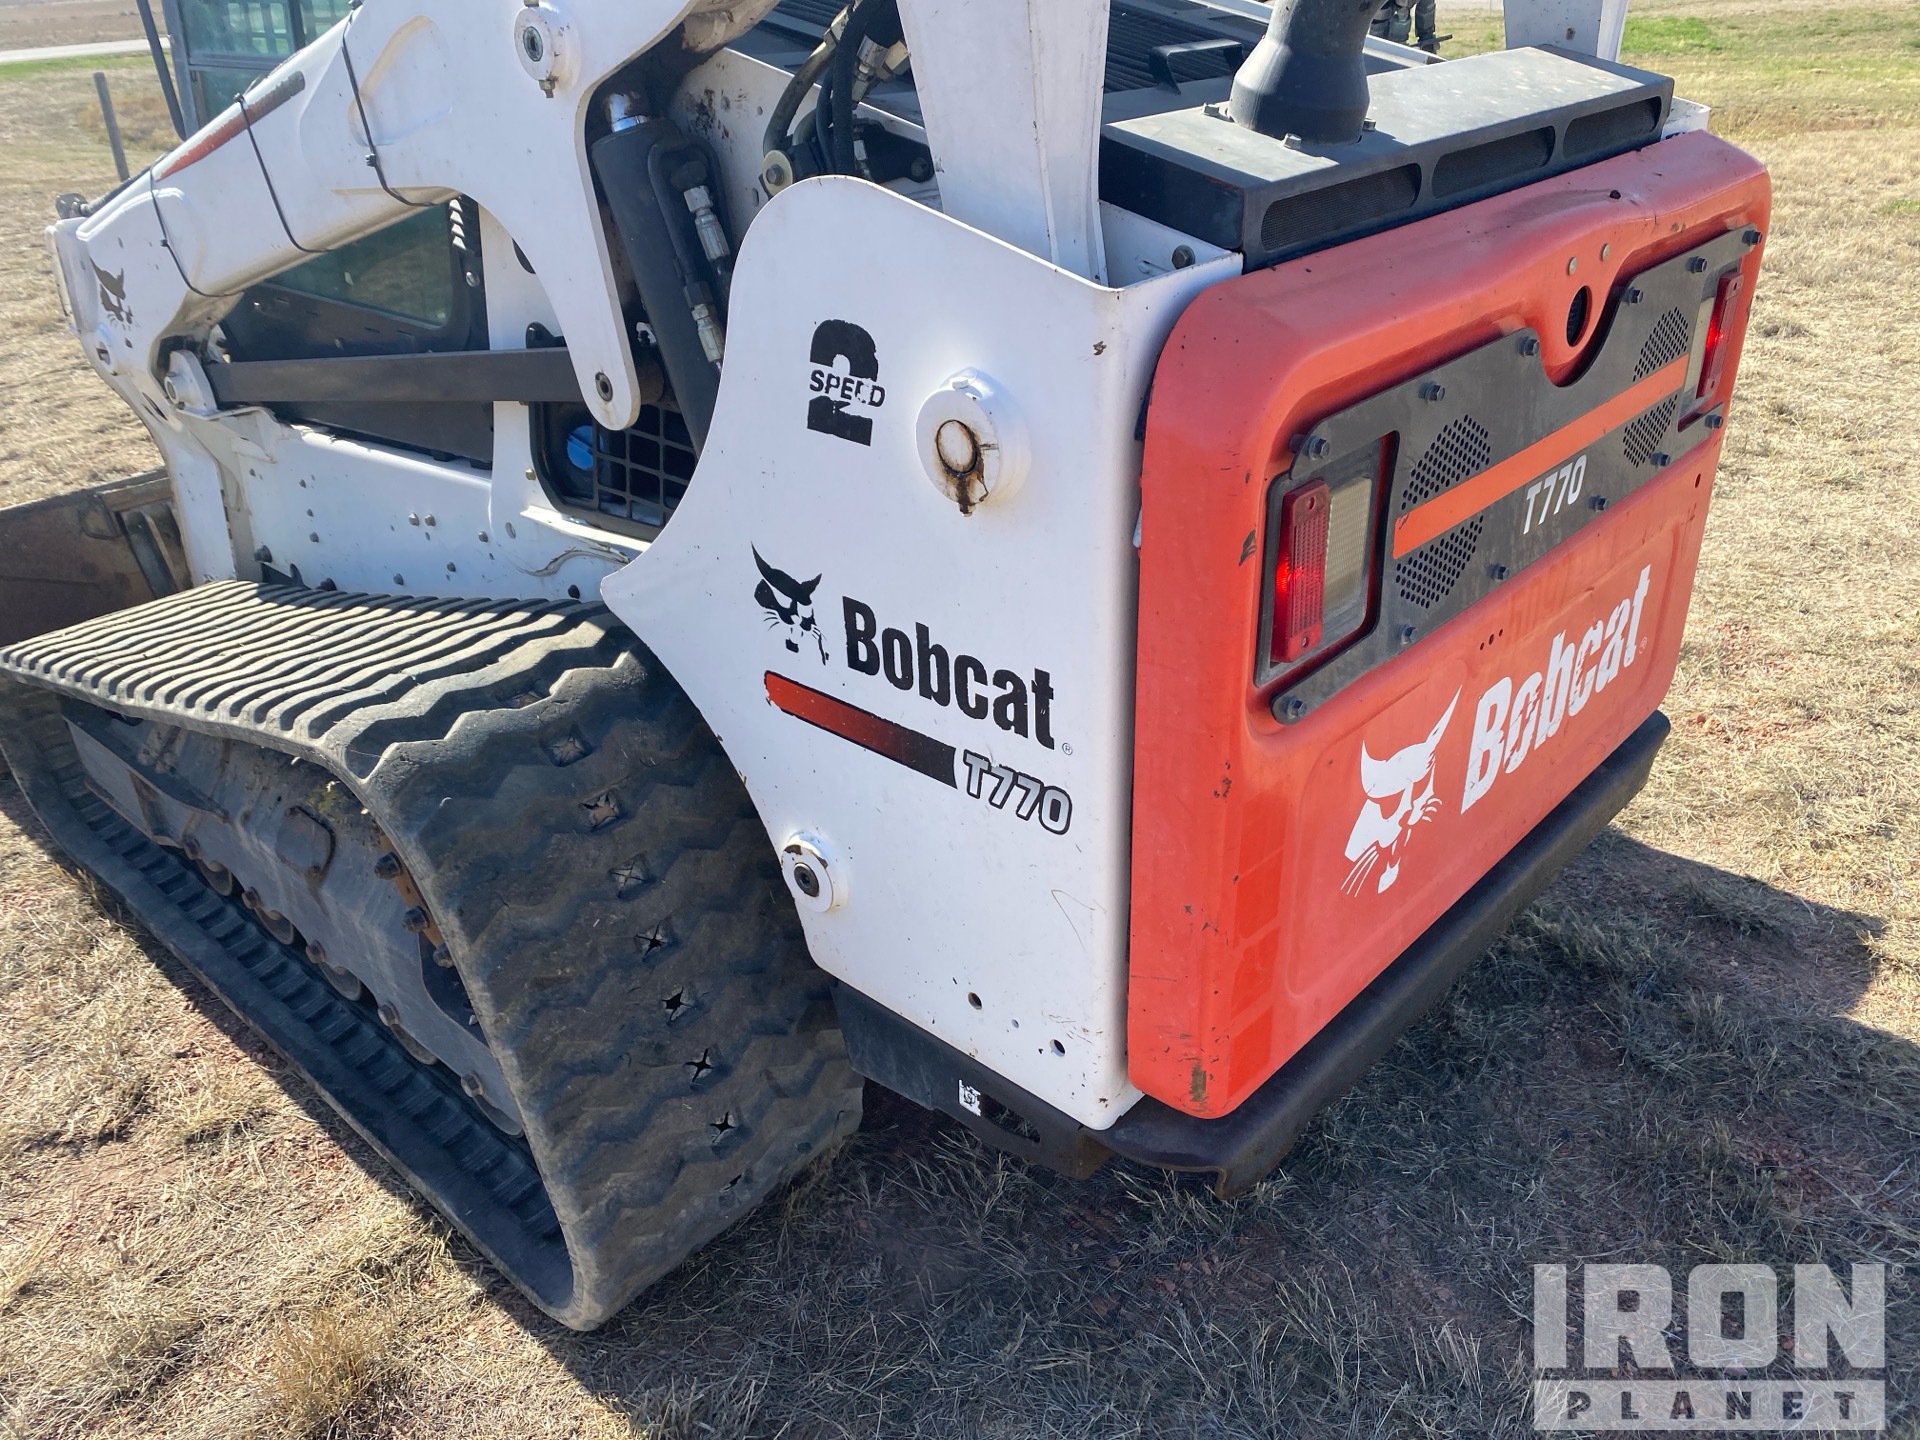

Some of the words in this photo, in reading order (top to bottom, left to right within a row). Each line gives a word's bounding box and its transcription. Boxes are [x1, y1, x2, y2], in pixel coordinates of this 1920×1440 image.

[807, 319, 879, 447] 2
[1523, 454, 1588, 535] T770
[842, 596, 1055, 750] Bobcat
[1461, 564, 1652, 815] Bobcat
[963, 749, 1073, 835] T770
